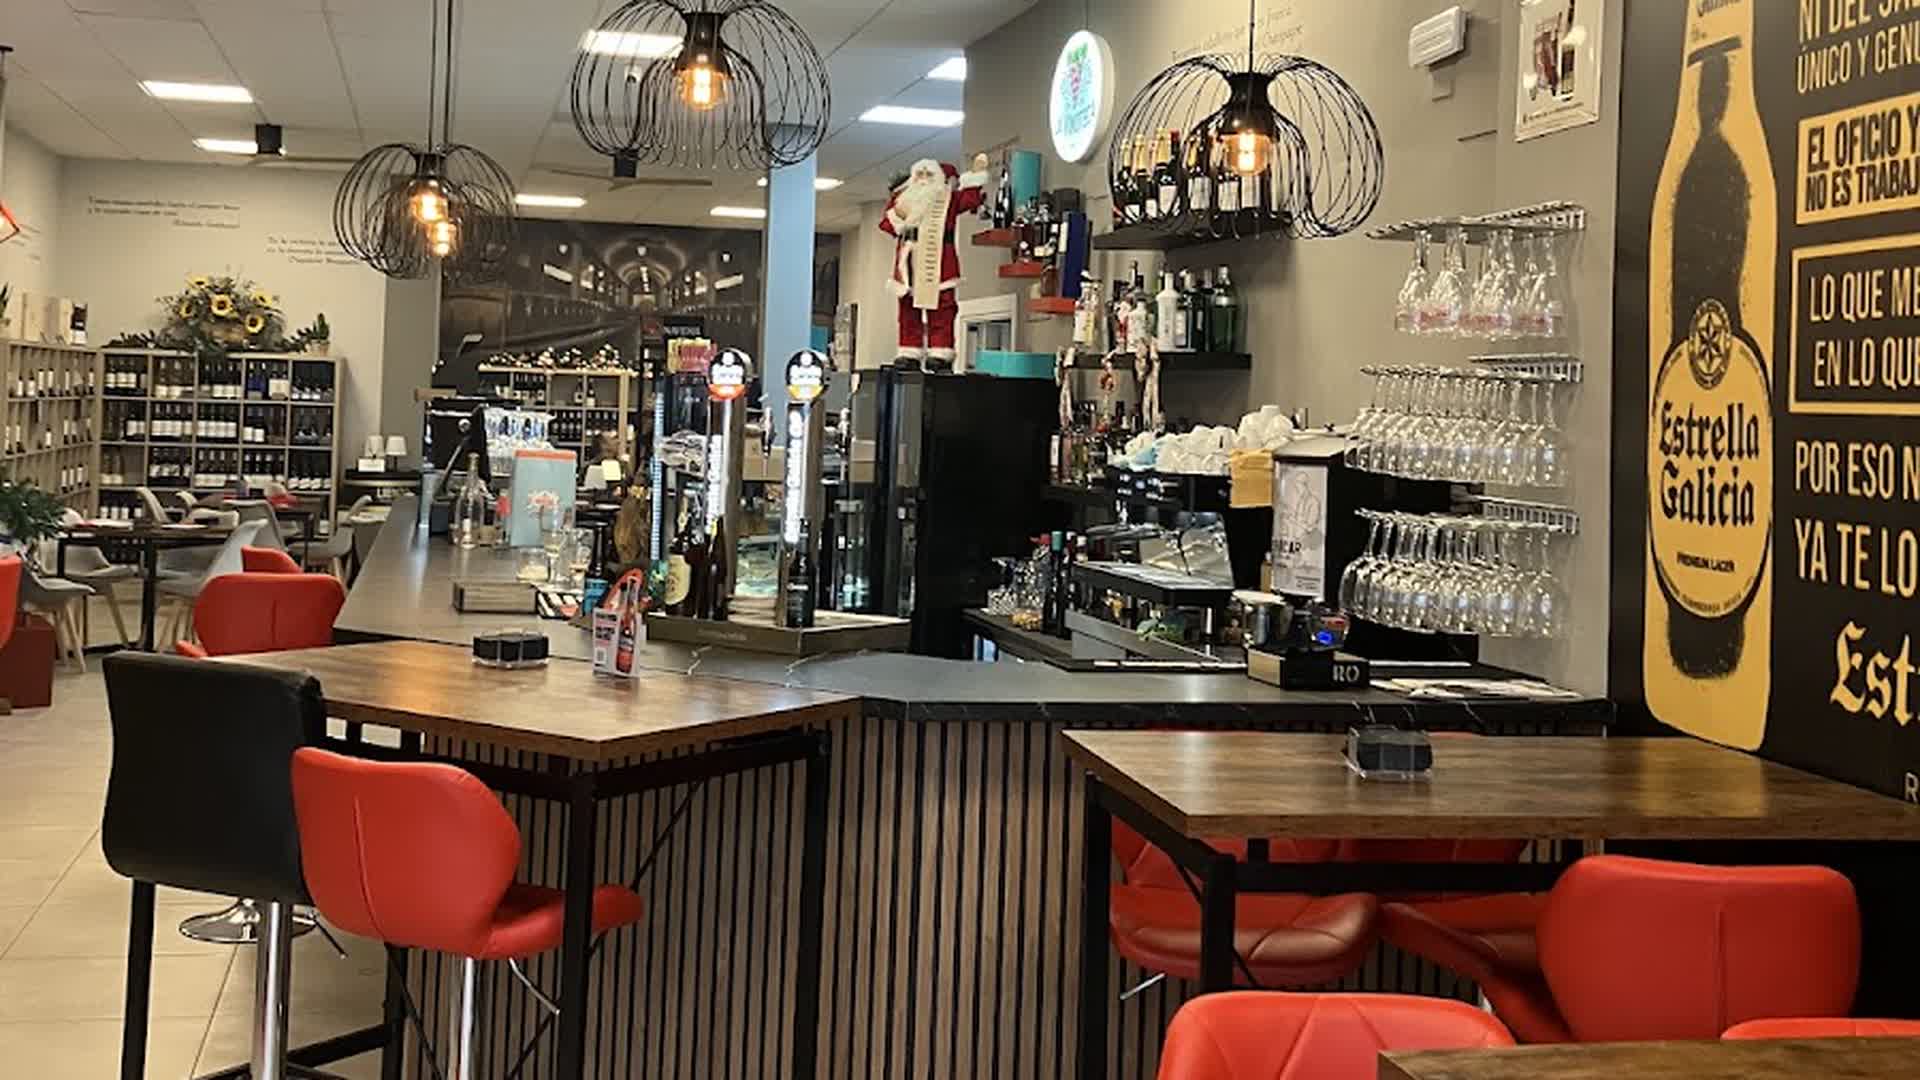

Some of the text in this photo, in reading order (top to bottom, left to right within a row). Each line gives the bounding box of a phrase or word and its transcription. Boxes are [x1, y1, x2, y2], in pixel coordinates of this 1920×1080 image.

[1797, 41, 1852, 94] ÚNICO
[1857, 34, 1870, 78] Y
[1807, 125, 1830, 173] EL
[1835, 107, 1902, 167] OFICIO
[1805, 173, 1827, 212] NO
[1831, 168, 1852, 207] ES
[1810, 273, 1836, 321] LO
[1841, 269, 1885, 323] QUE
[1815, 340, 1842, 387] EN
[1848, 337, 1875, 387] LO
[1659, 400, 1759, 461] Estrella
[1661, 460, 1754, 527] Galicia
[1795, 440, 1840, 494] POR
[1848, 442, 1894, 499] ESO
[1795, 518, 1918, 598] YA TE LO
[1830, 620, 1920, 726] Est
